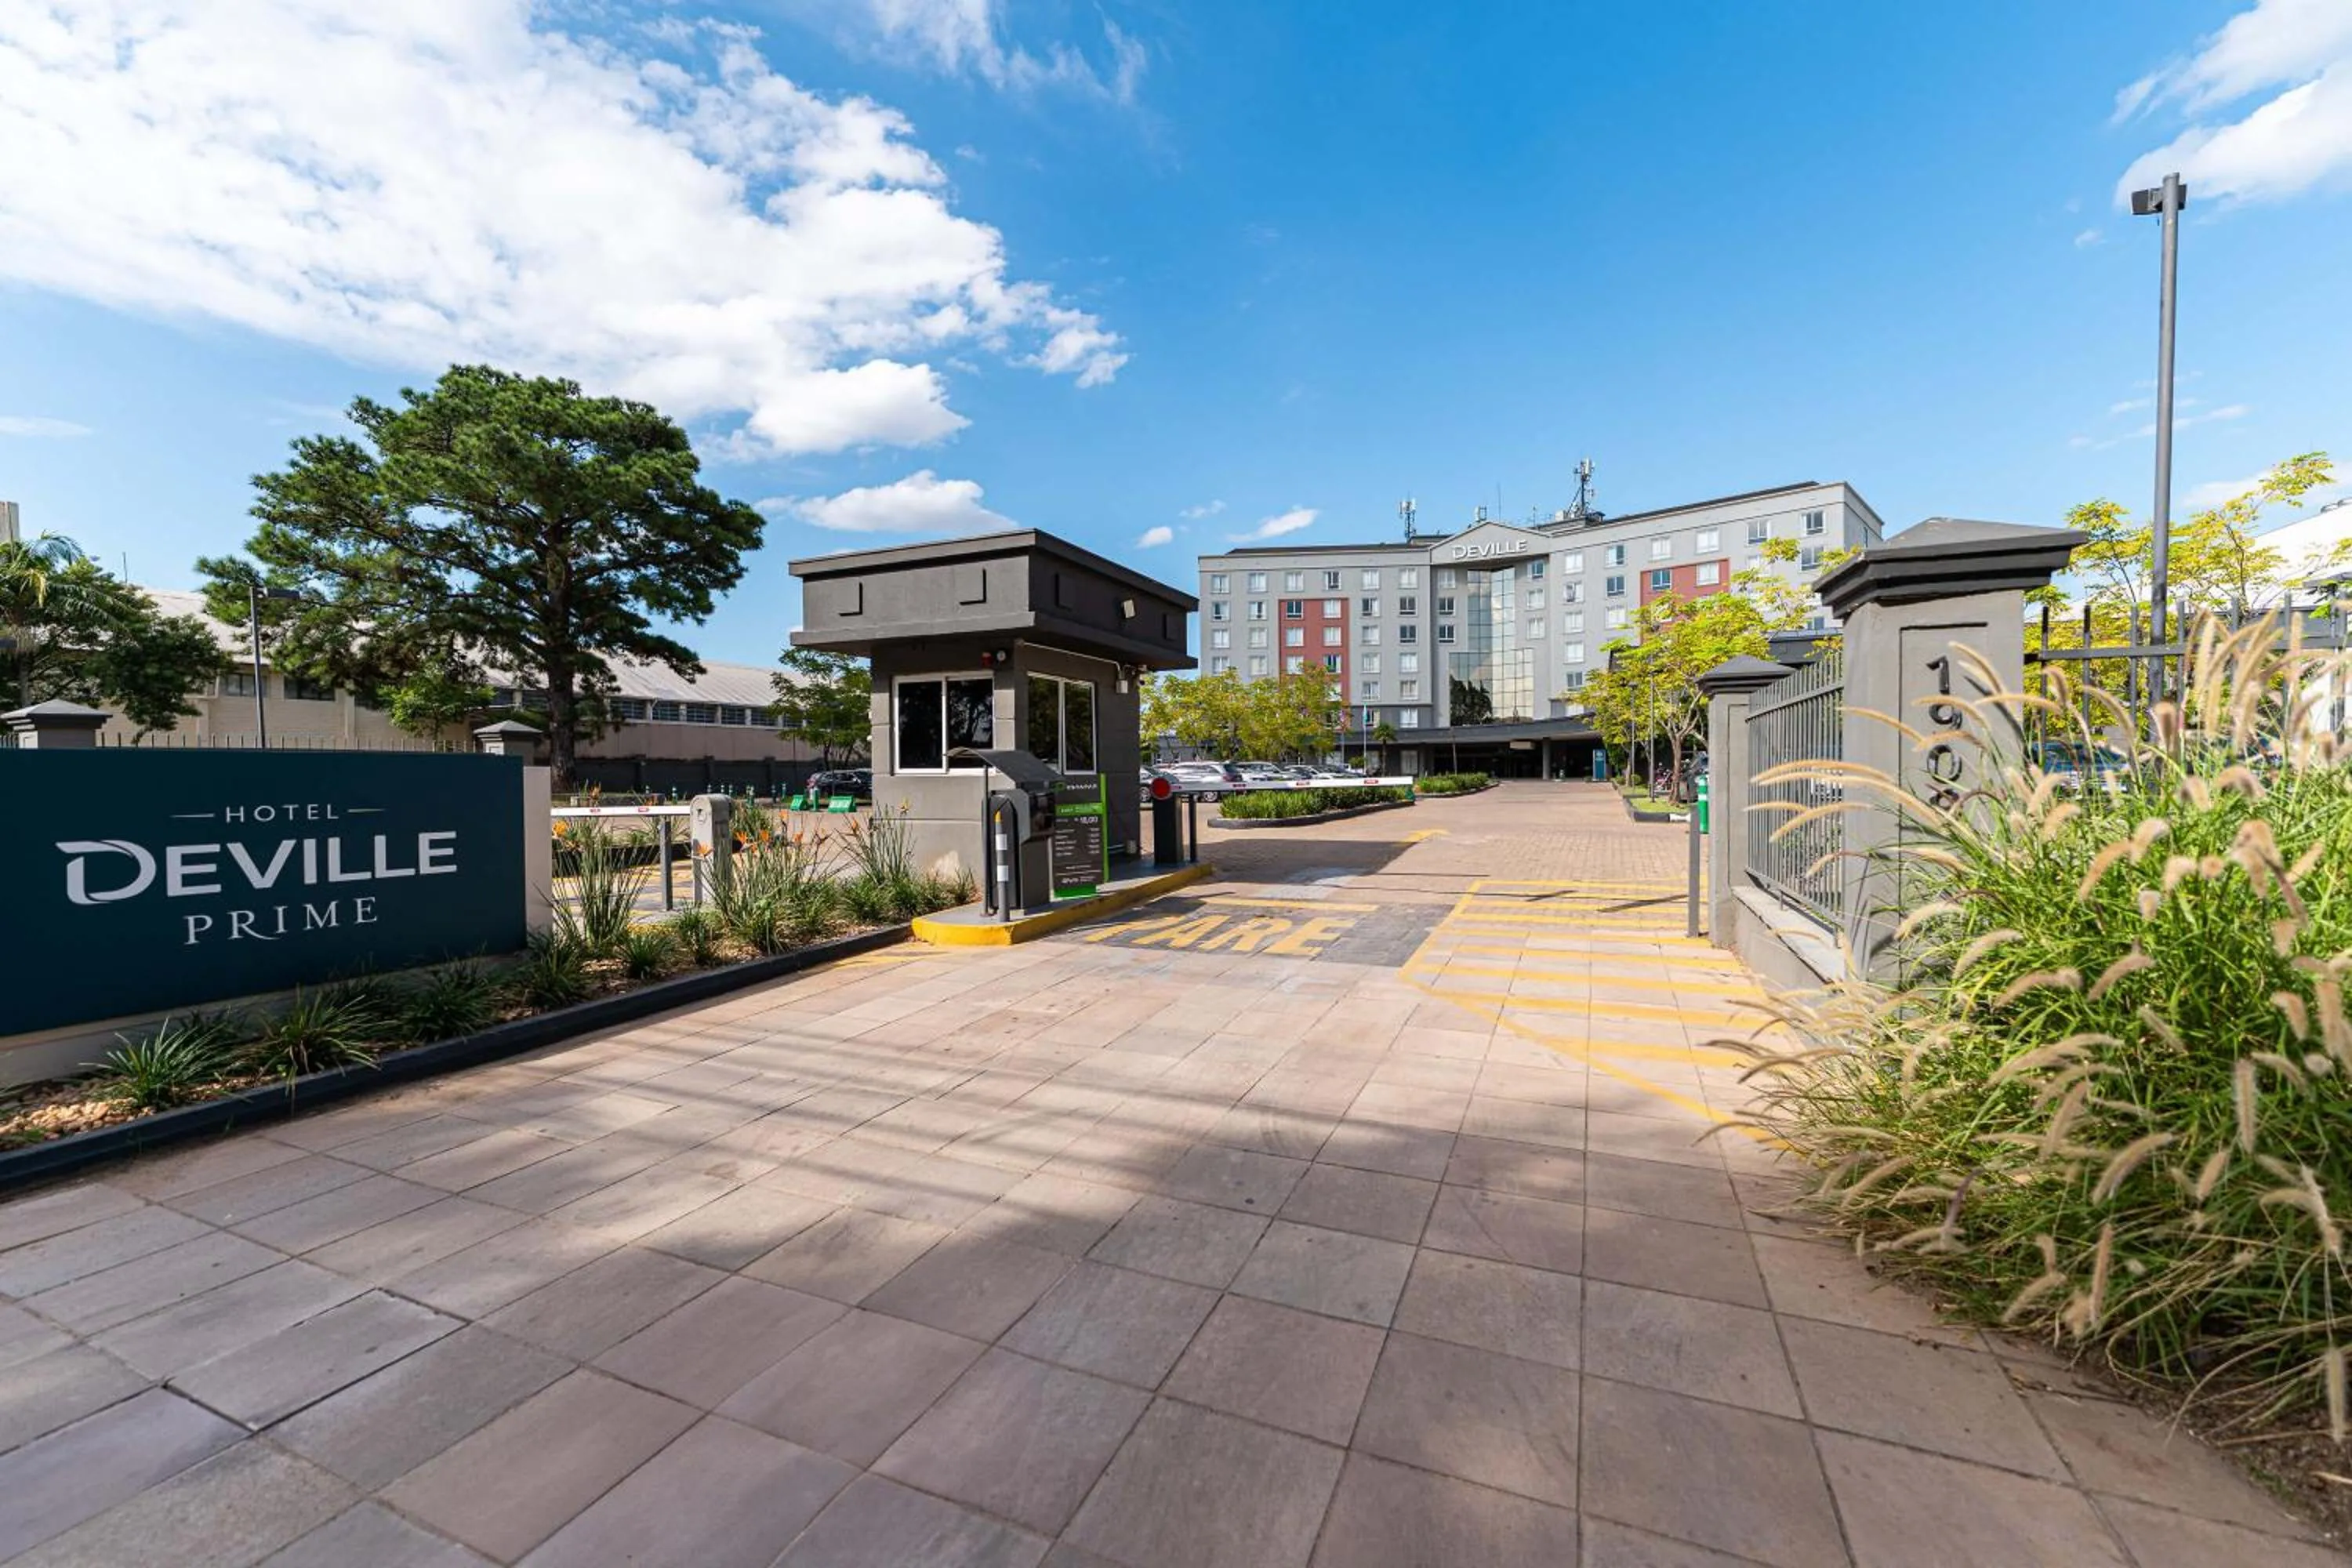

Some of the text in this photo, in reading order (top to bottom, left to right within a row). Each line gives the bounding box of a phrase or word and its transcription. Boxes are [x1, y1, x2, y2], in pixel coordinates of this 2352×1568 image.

[1453, 539, 1528, 559] DEVILLE
[225, 804, 339, 823] HOTEL
[55, 831, 458, 905] DEVILLE
[183, 897, 379, 945] PRIME
[1085, 914, 1357, 956] PARE
